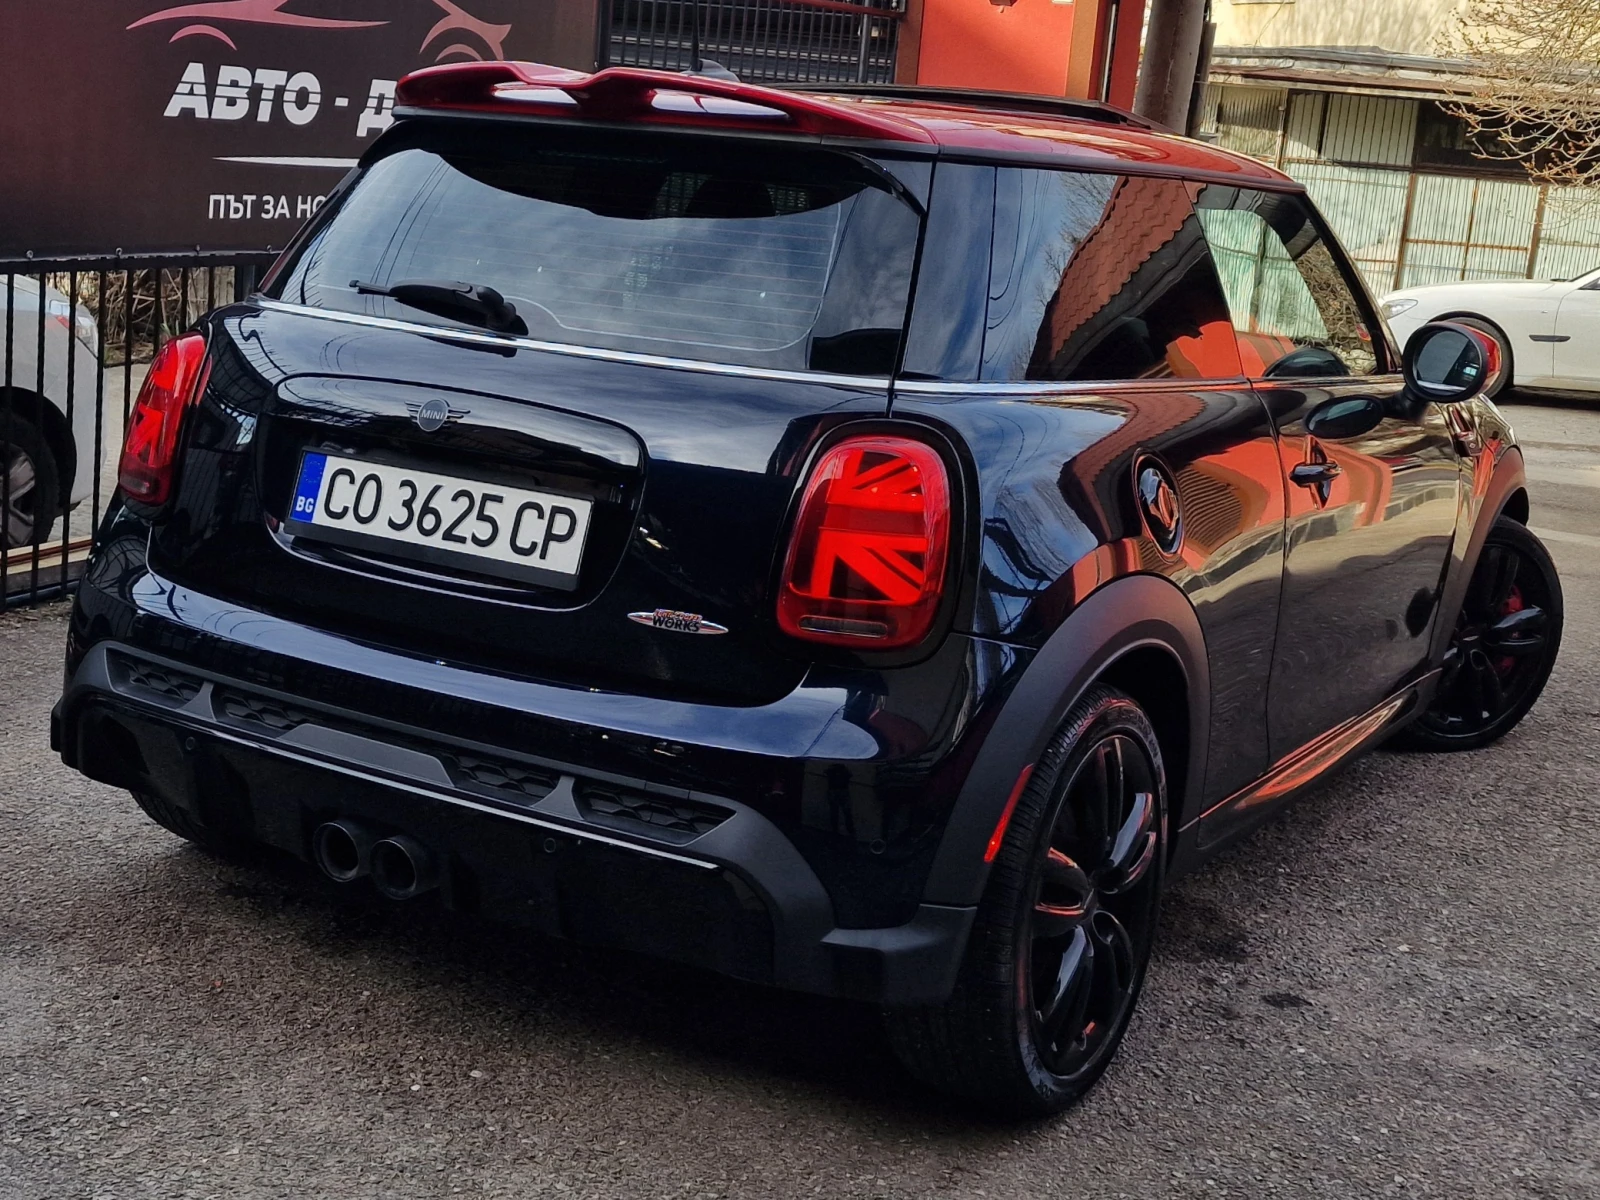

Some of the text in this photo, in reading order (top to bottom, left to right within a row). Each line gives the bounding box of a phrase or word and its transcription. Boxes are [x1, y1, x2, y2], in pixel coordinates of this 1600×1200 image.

[163, 62, 321, 125] АВТО
[208, 194, 257, 220] ПЪТ
[261, 194, 290, 219] ЗА
[421, 409, 444, 420] MINI
[295, 495, 315, 513] BG
[387, 479, 504, 548] 3625
[509, 501, 577, 560] CP
[652, 615, 700, 632] WORKS
